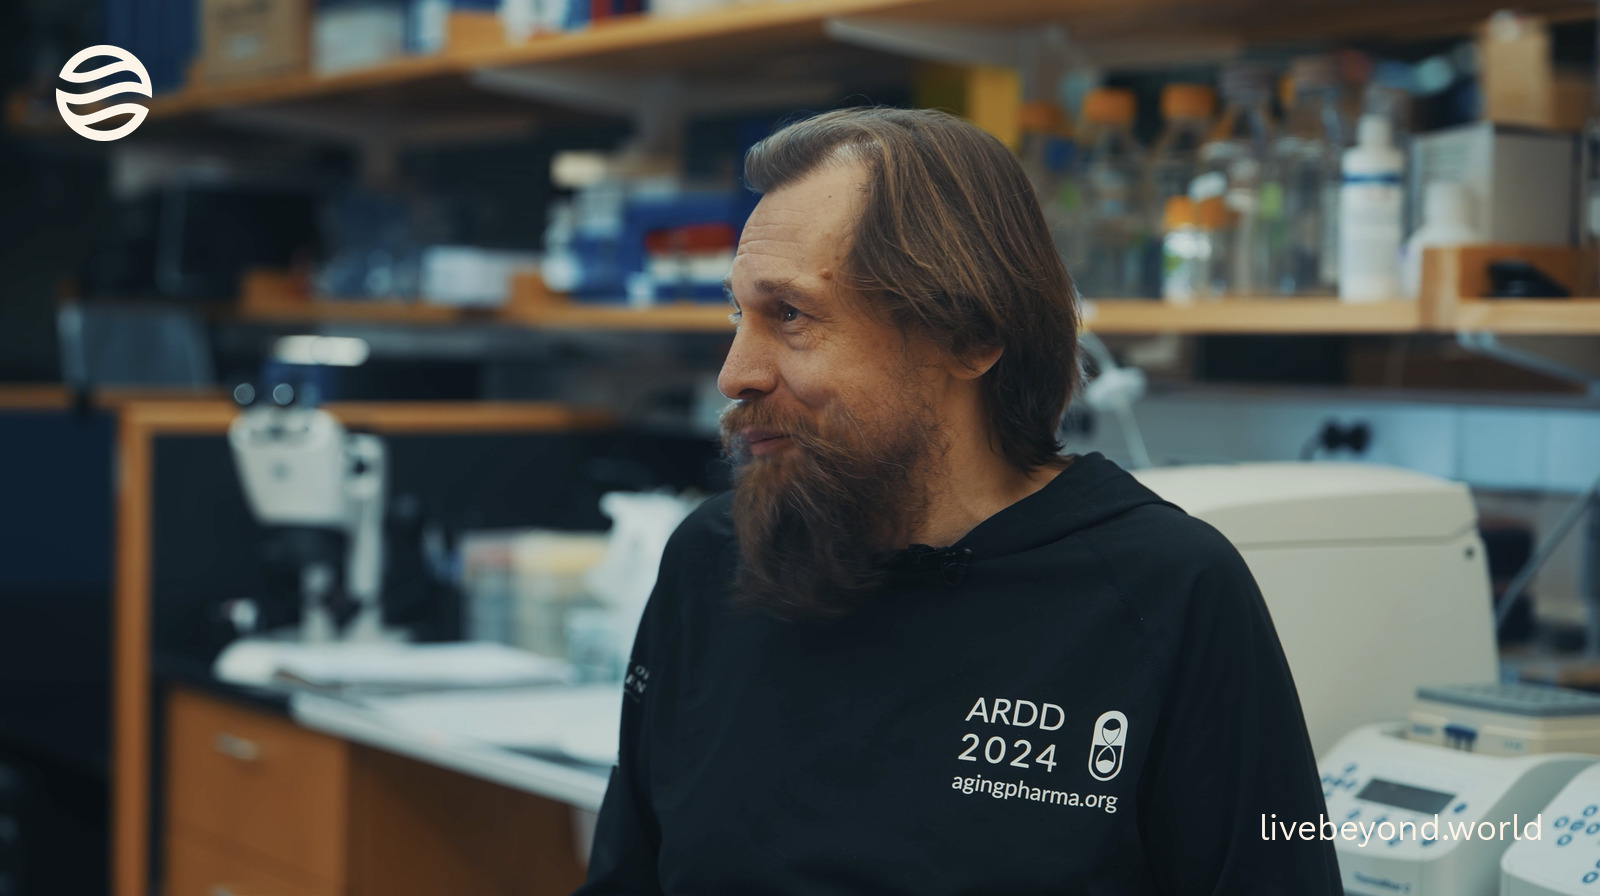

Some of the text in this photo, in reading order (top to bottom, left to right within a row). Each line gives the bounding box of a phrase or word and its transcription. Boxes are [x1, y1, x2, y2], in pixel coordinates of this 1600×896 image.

[965, 697, 1065, 731] ARDD
[958, 733, 1057, 772] 2024
[952, 774, 1118, 813] agingpharma.org
